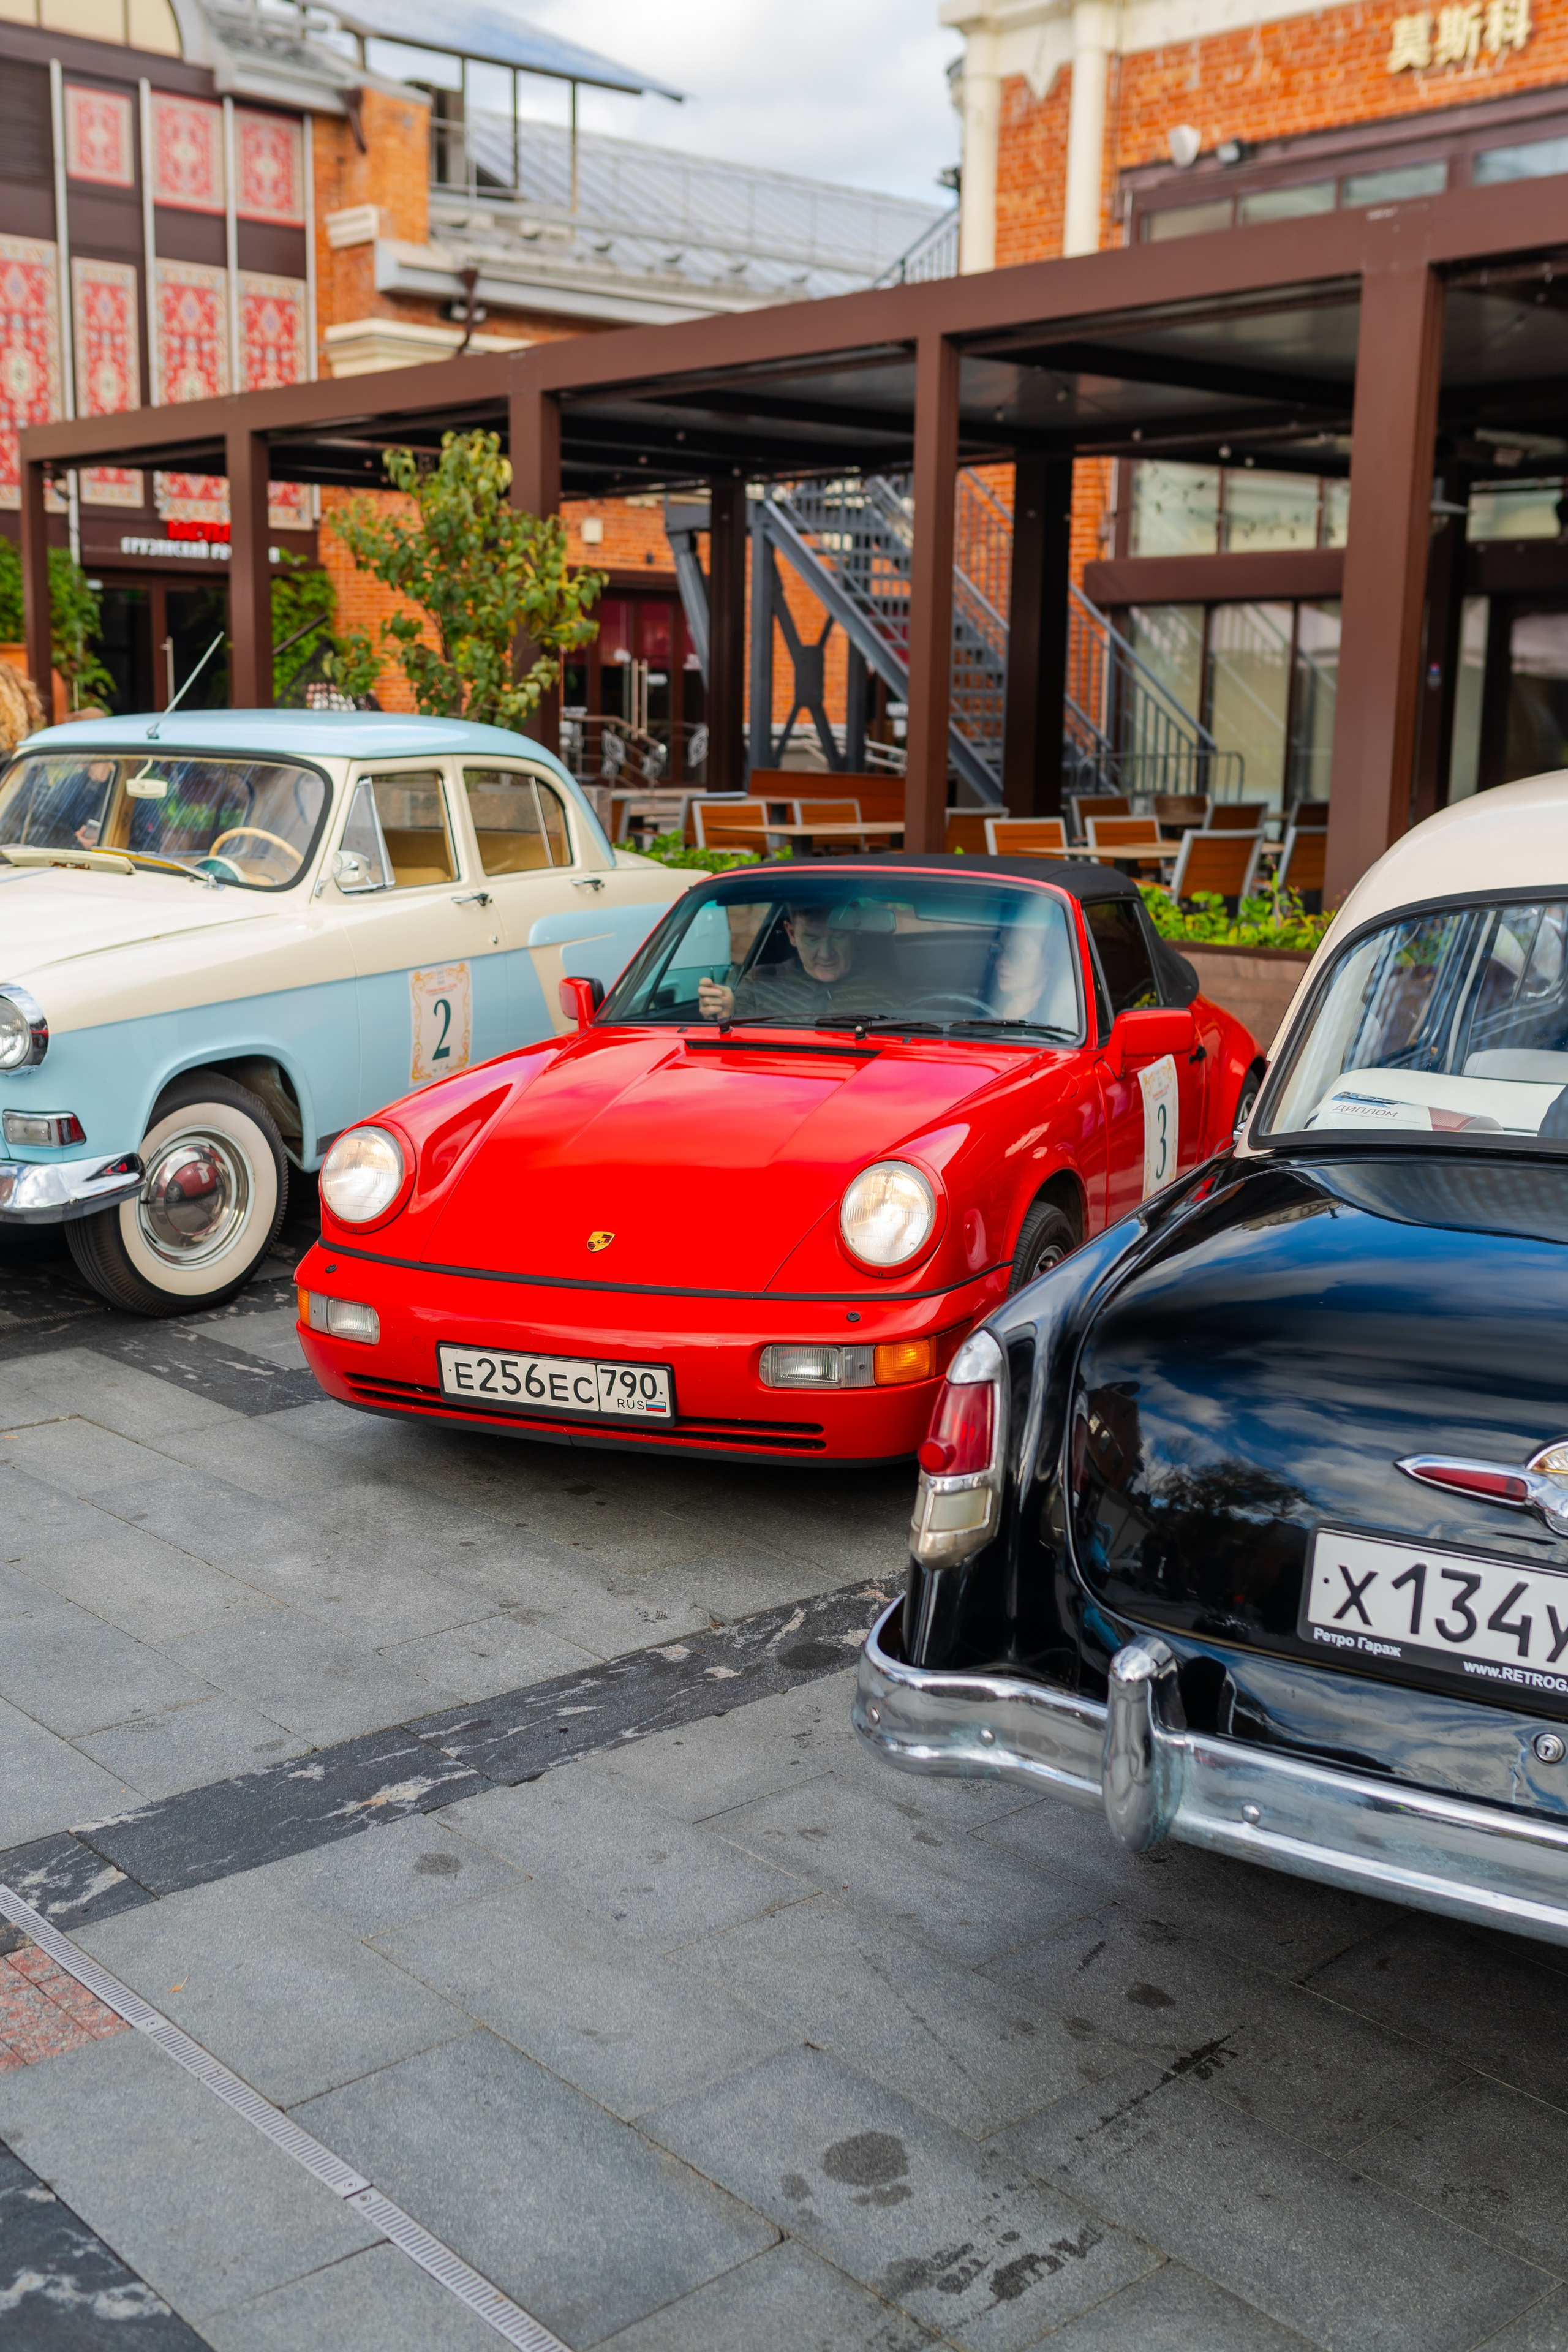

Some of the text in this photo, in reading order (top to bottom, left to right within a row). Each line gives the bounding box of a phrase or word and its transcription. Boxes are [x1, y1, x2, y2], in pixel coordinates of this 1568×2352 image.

[432, 998, 451, 1061] 2
[1332, 1104, 1398, 1117] ДИПЛОМ
[1156, 1104, 1167, 1180] 3
[600, 1368, 657, 1400] 790
[617, 1398, 644, 1410] RUS
[1313, 1627, 1401, 1657] Ретро Гараж
[1463, 1661, 1568, 1693] www.RETROG
